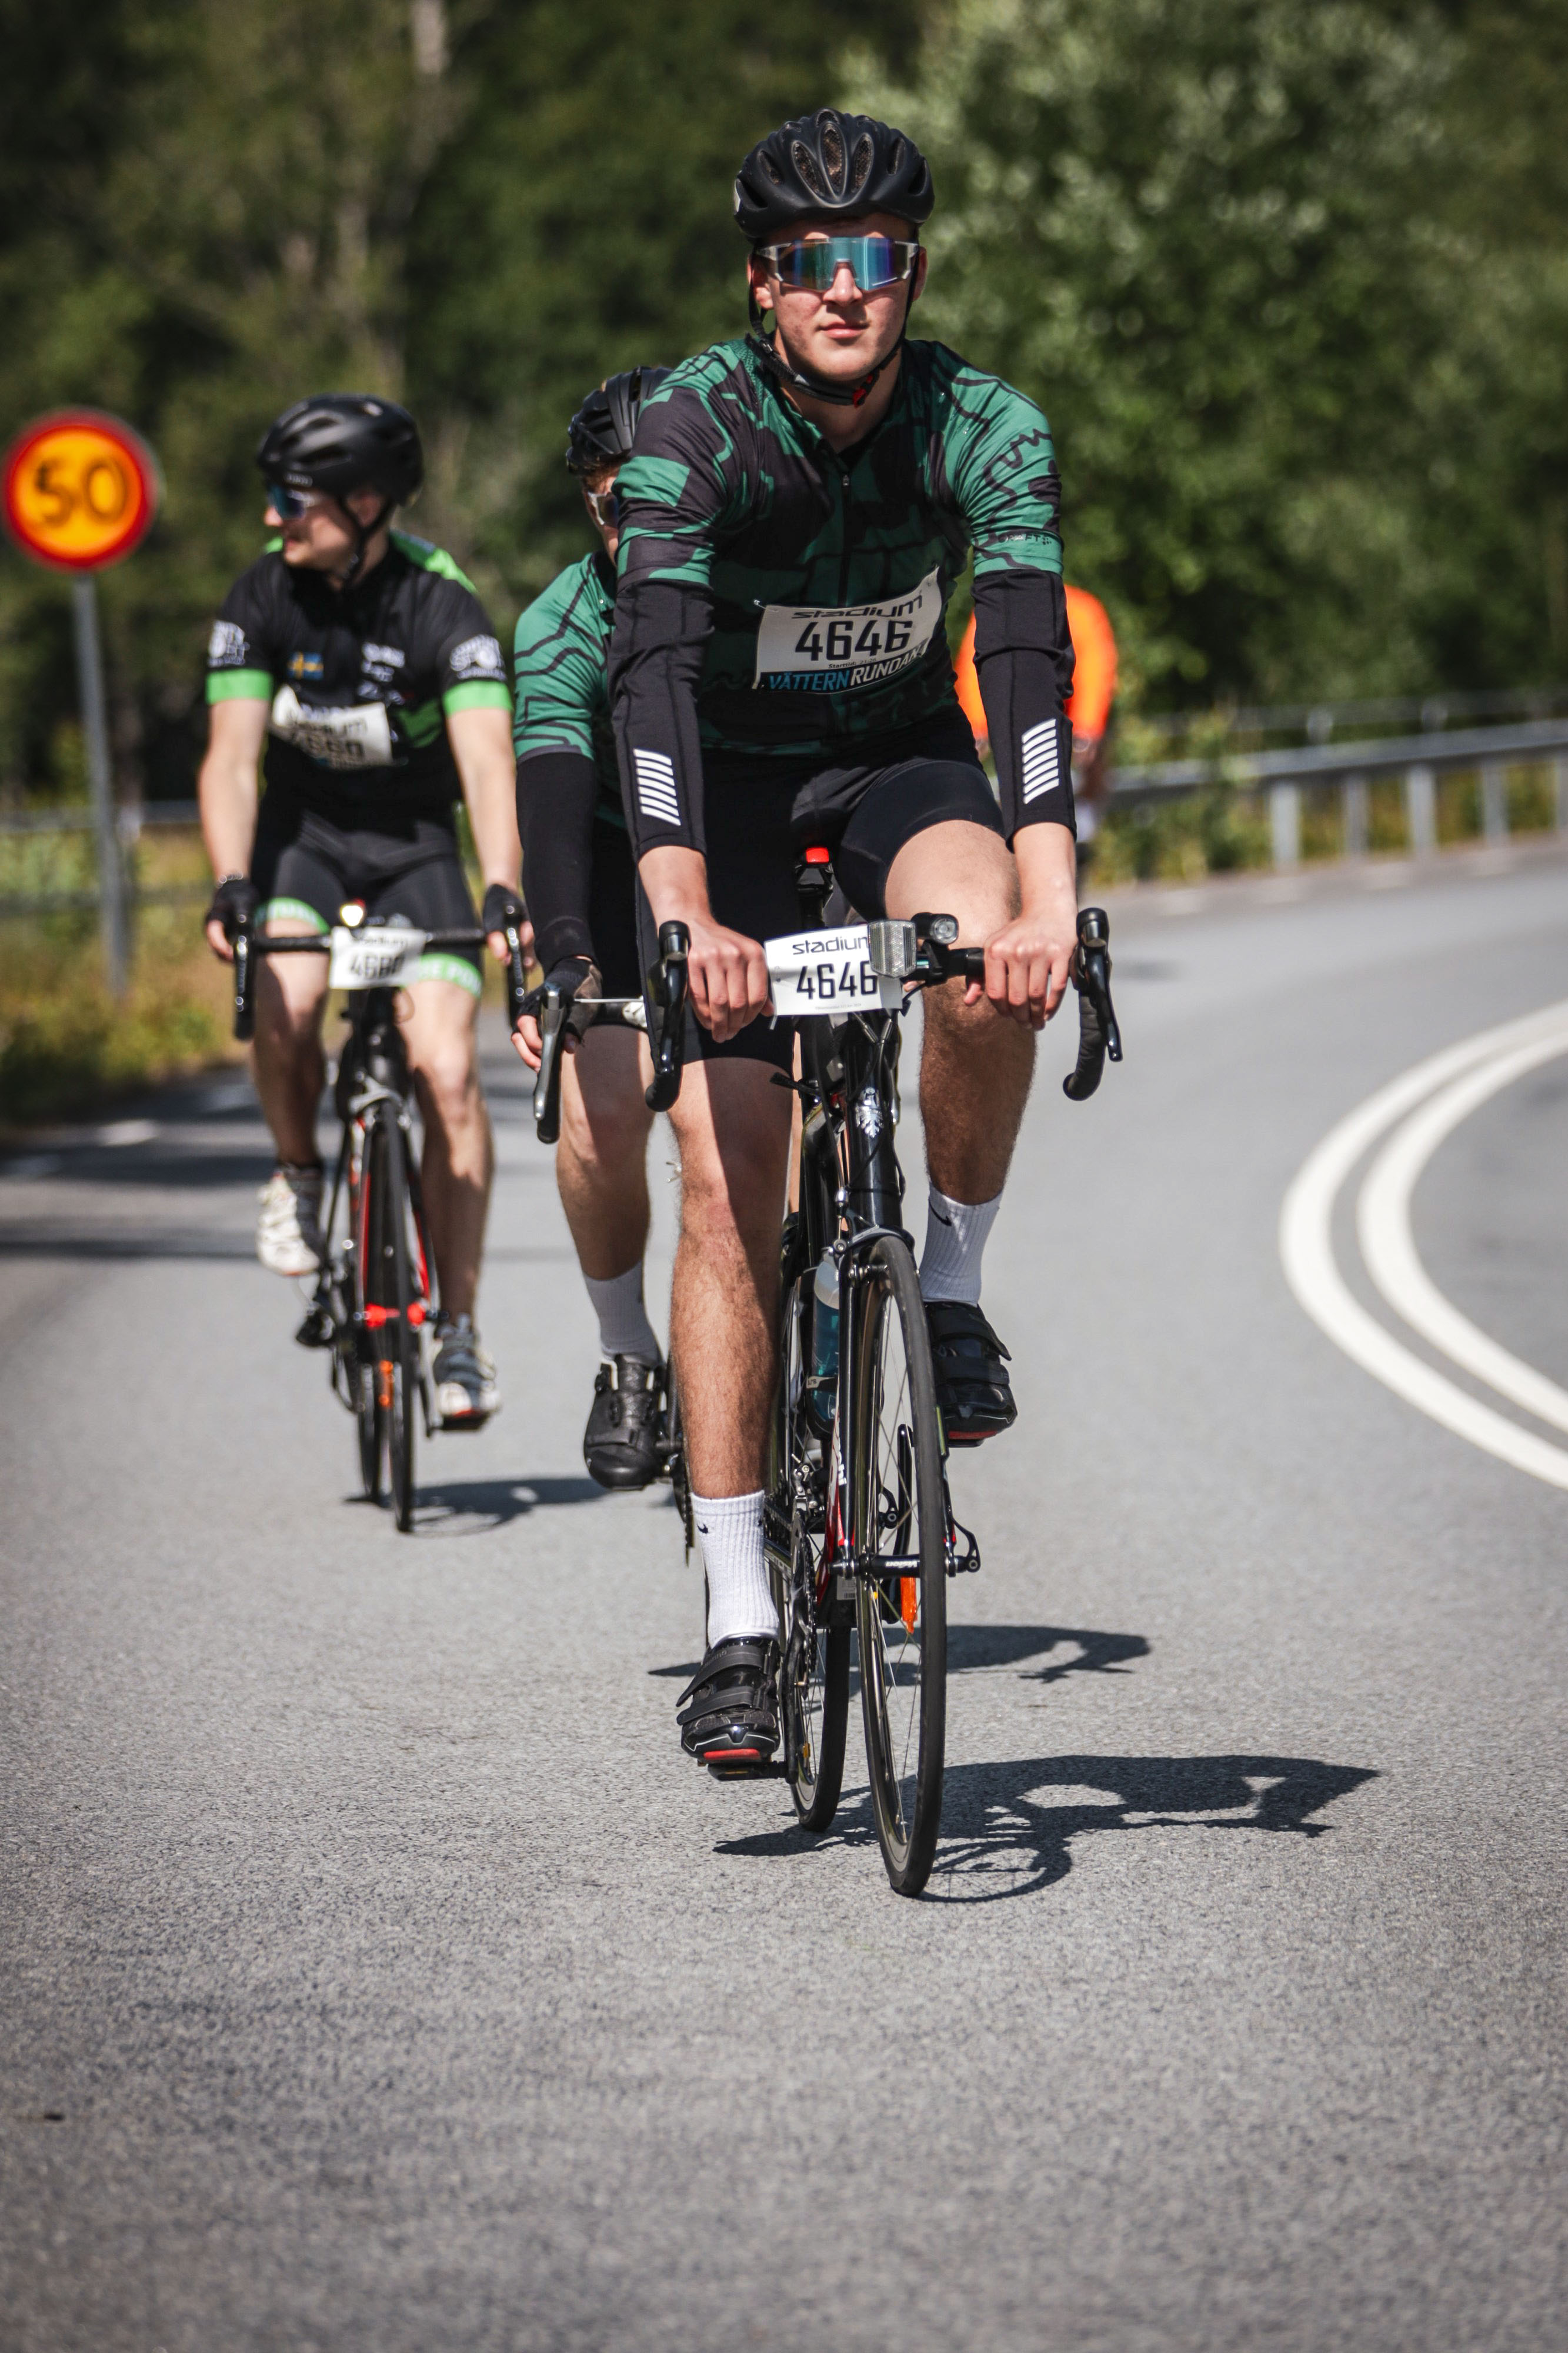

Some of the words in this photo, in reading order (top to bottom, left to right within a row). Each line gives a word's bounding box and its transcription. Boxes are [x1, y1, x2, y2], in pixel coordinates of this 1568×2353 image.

[34, 457, 129, 528] 50
[792, 594, 923, 619] stadium
[795, 619, 913, 661] 4646
[796, 960, 879, 1000] 4646
